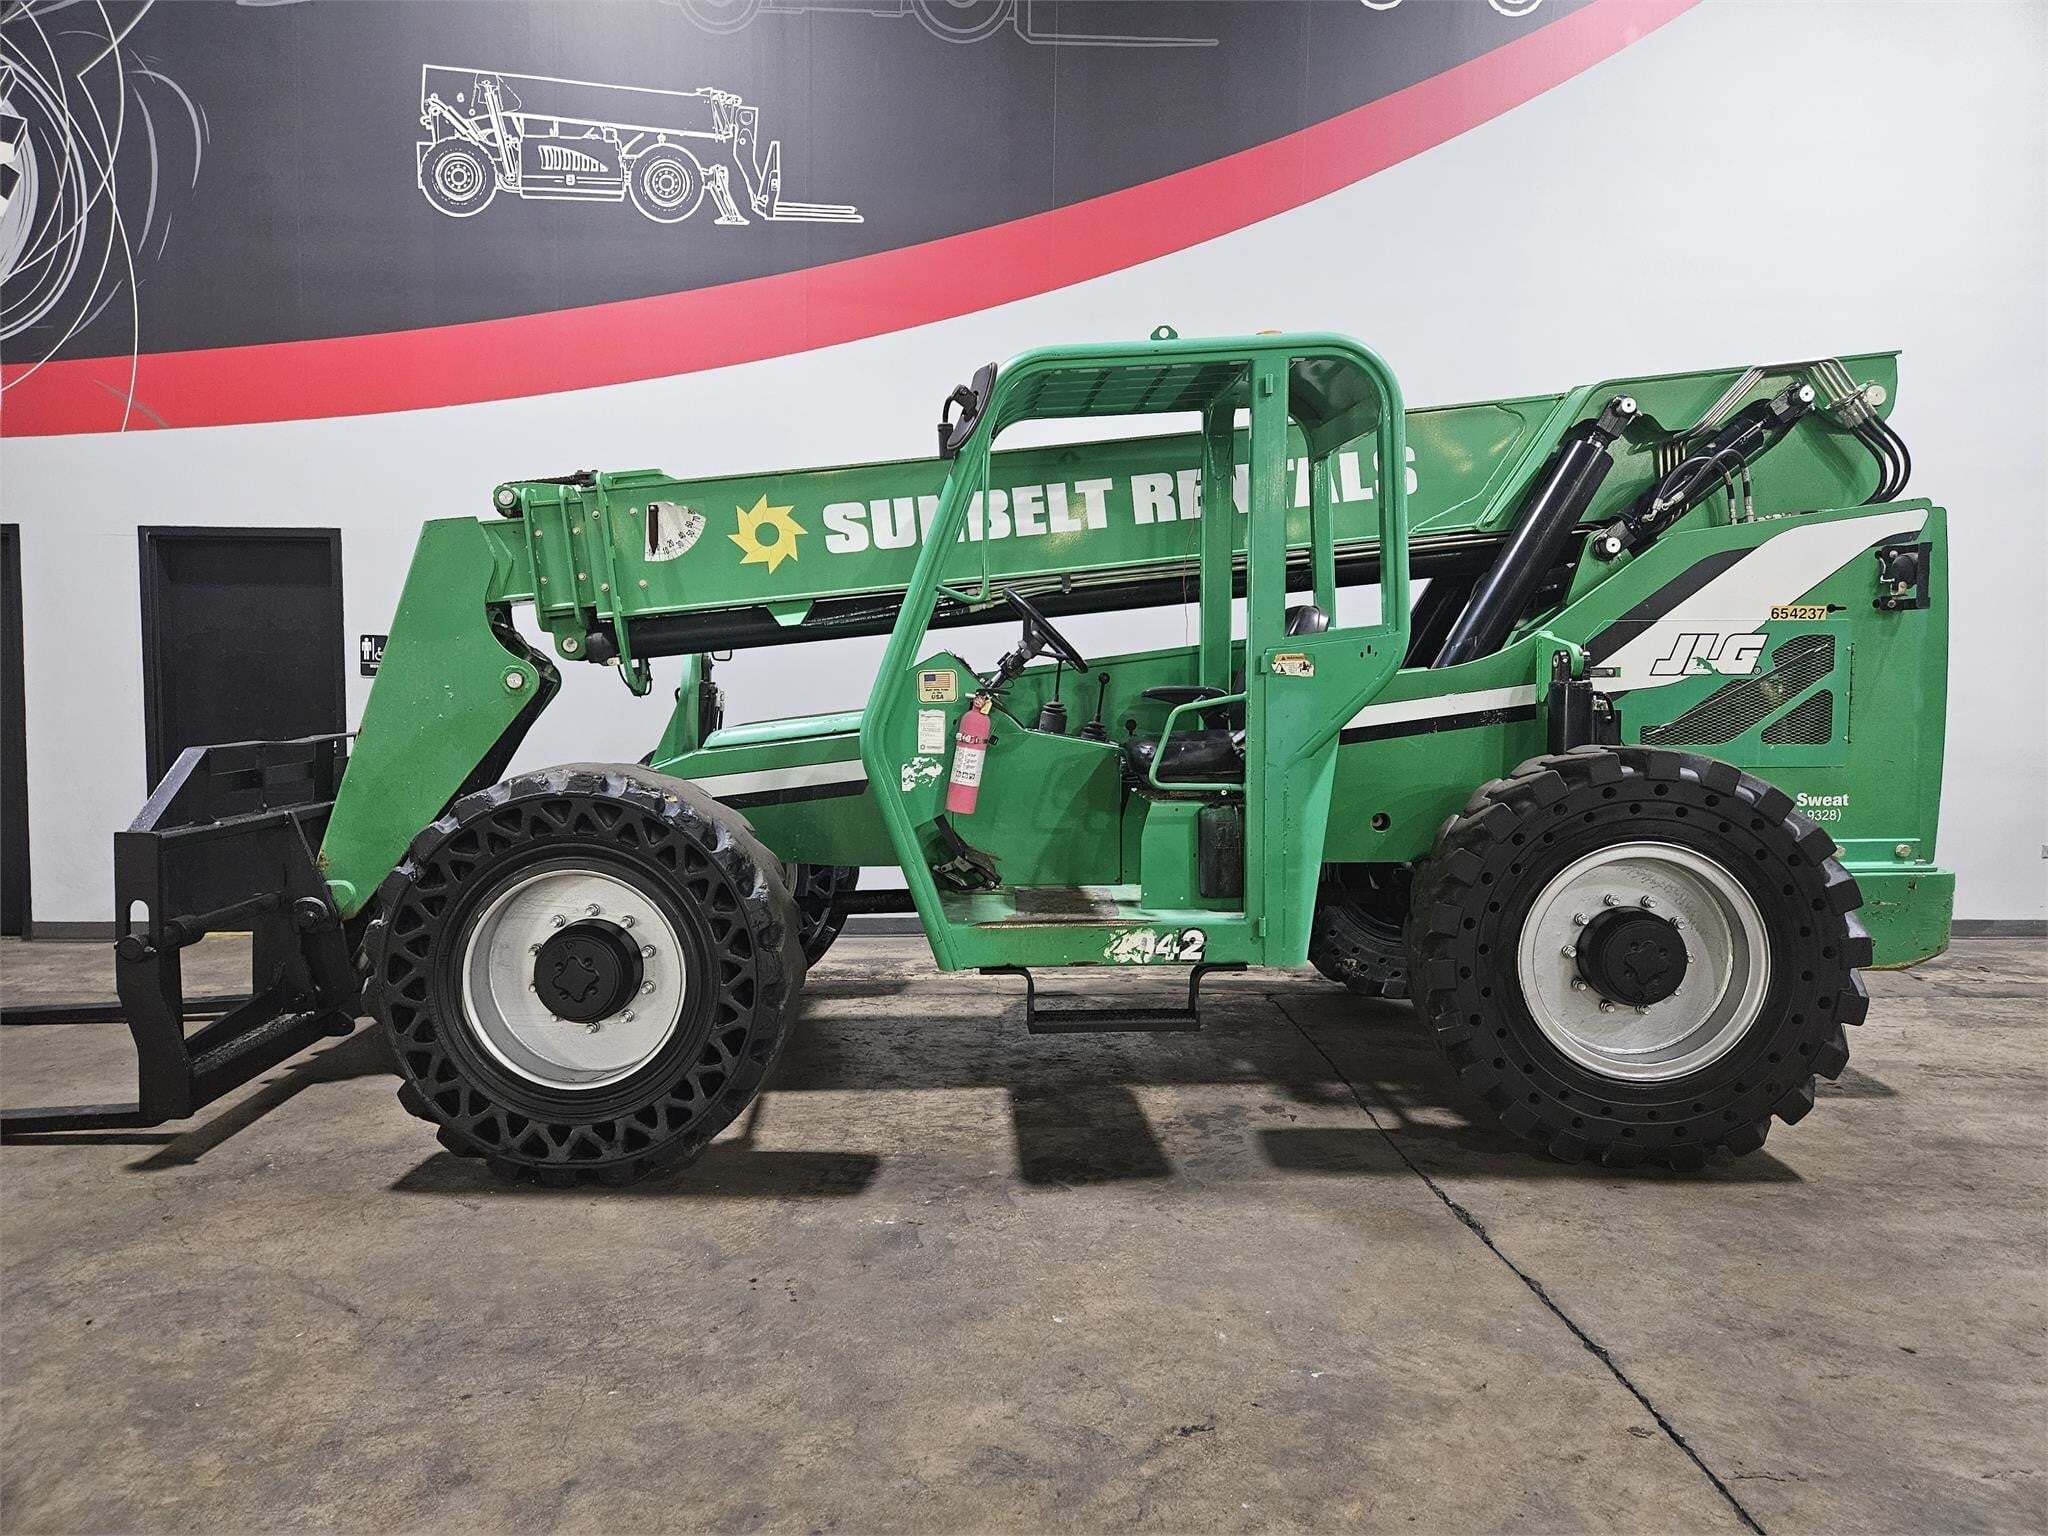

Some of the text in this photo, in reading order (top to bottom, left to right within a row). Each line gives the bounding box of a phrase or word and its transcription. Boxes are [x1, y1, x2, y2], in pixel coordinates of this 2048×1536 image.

[1131, 446, 1418, 525] REAL
[1771, 607, 1825, 619] 654237
[1650, 633, 1769, 675] JLG
[1797, 792, 1849, 806] Sweat
[1800, 809, 1841, 822] 9328)
